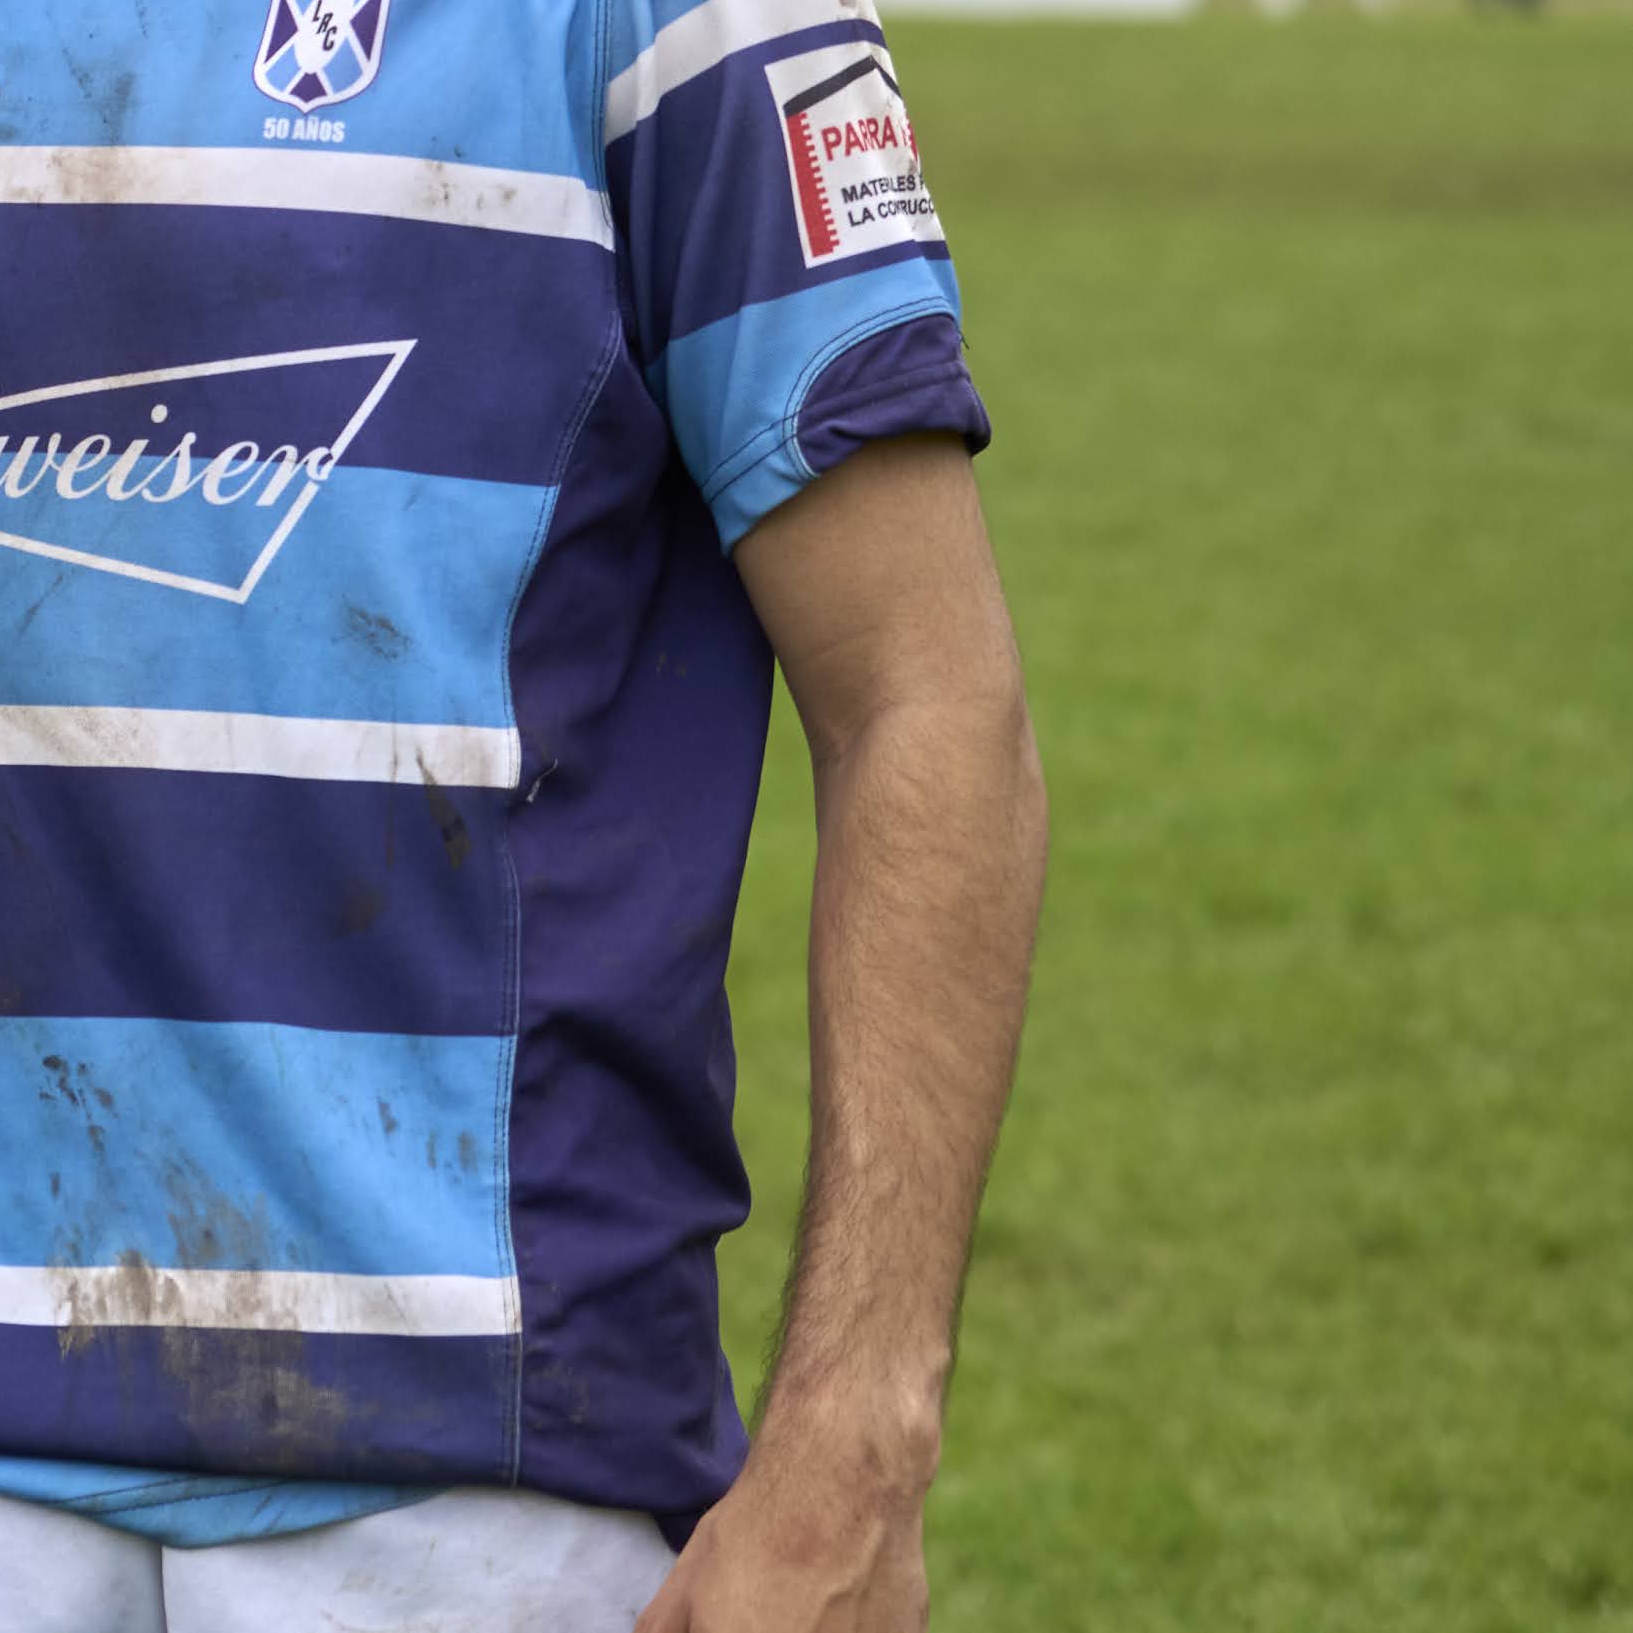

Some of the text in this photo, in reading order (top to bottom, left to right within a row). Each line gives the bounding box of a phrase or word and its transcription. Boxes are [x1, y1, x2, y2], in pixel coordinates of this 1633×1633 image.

[262, 115, 346, 144] 50 AÑOS
[821, 115, 899, 162] PARRA
[848, 207, 875, 228] LA
